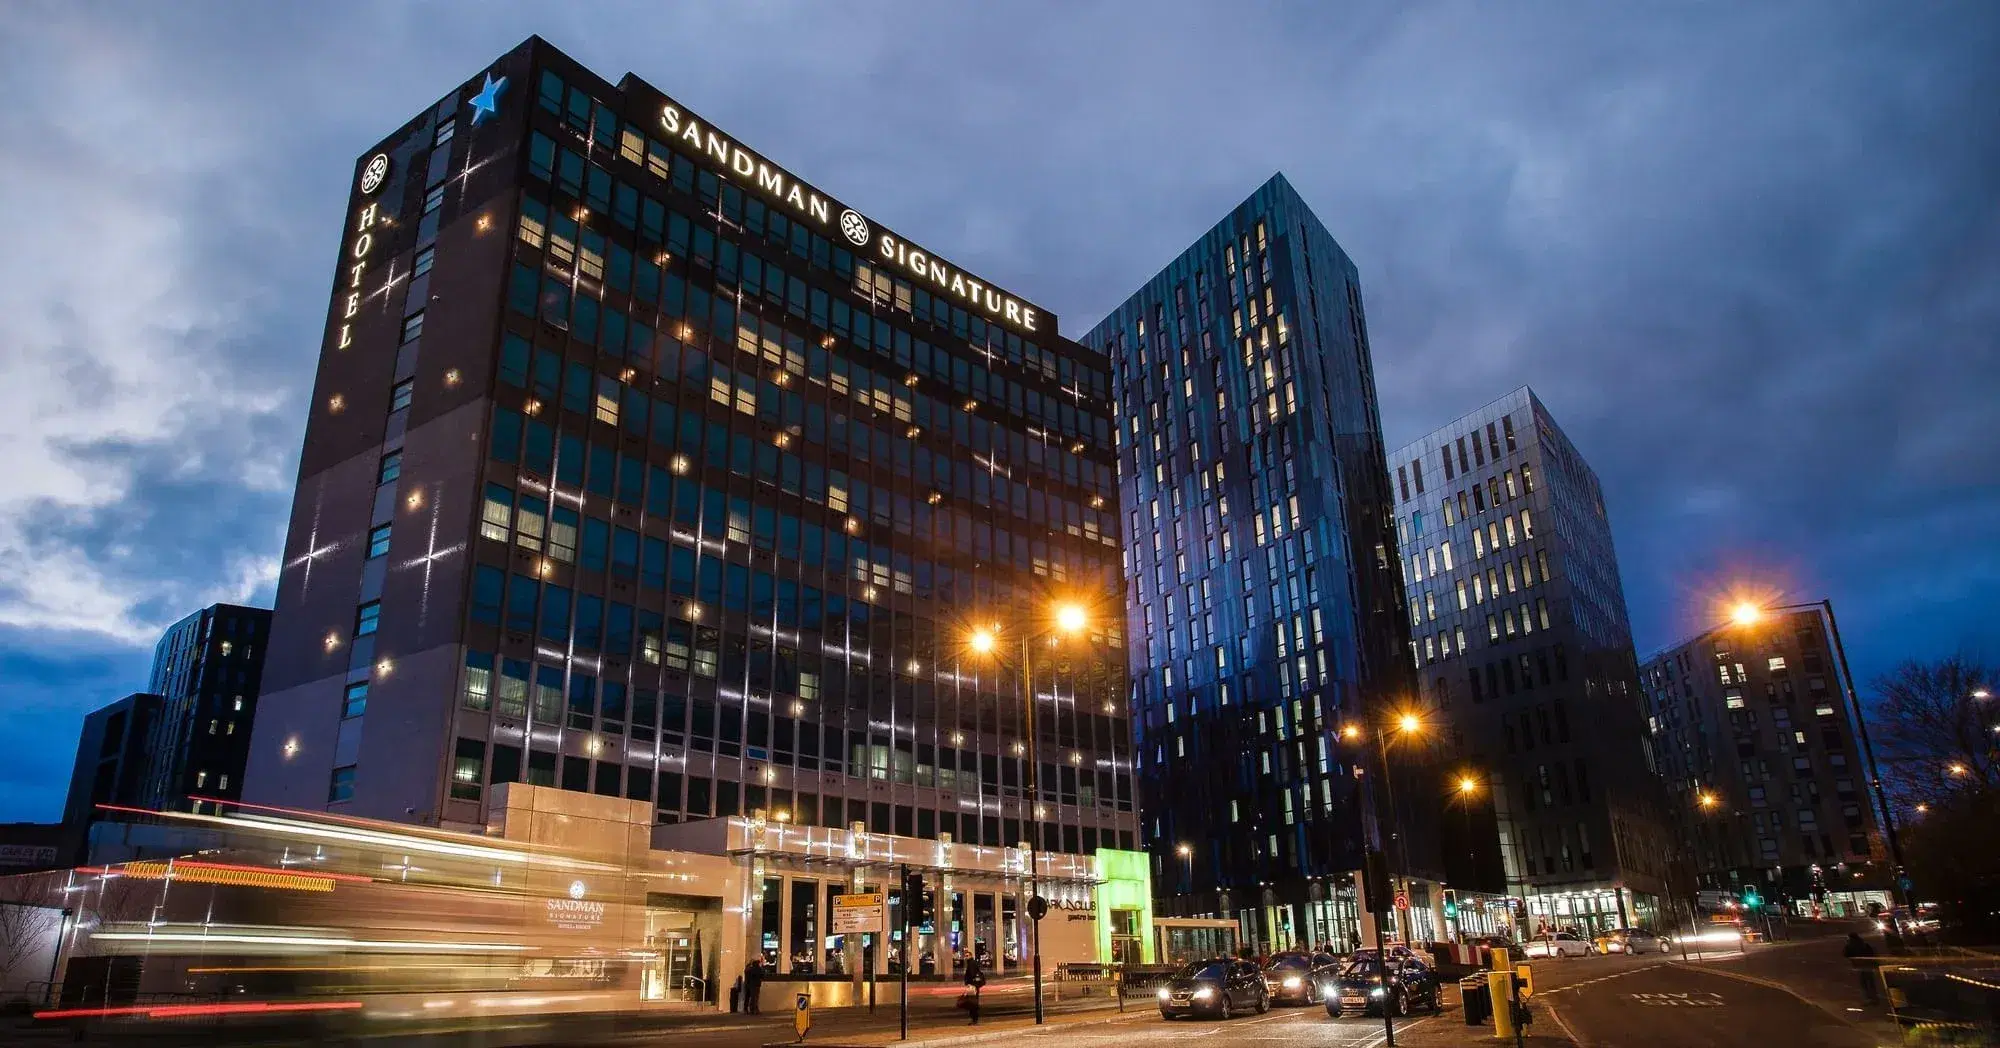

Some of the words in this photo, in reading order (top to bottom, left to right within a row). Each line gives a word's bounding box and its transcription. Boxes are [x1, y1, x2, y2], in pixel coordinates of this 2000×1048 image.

[661, 106, 829, 224] SANDMAN
[880, 234, 1037, 331] SIGNATURE
[338, 202, 378, 350] HOTEL
[546, 898, 604, 913] SANDMAN
[549, 911, 602, 921] SIGNATURE
